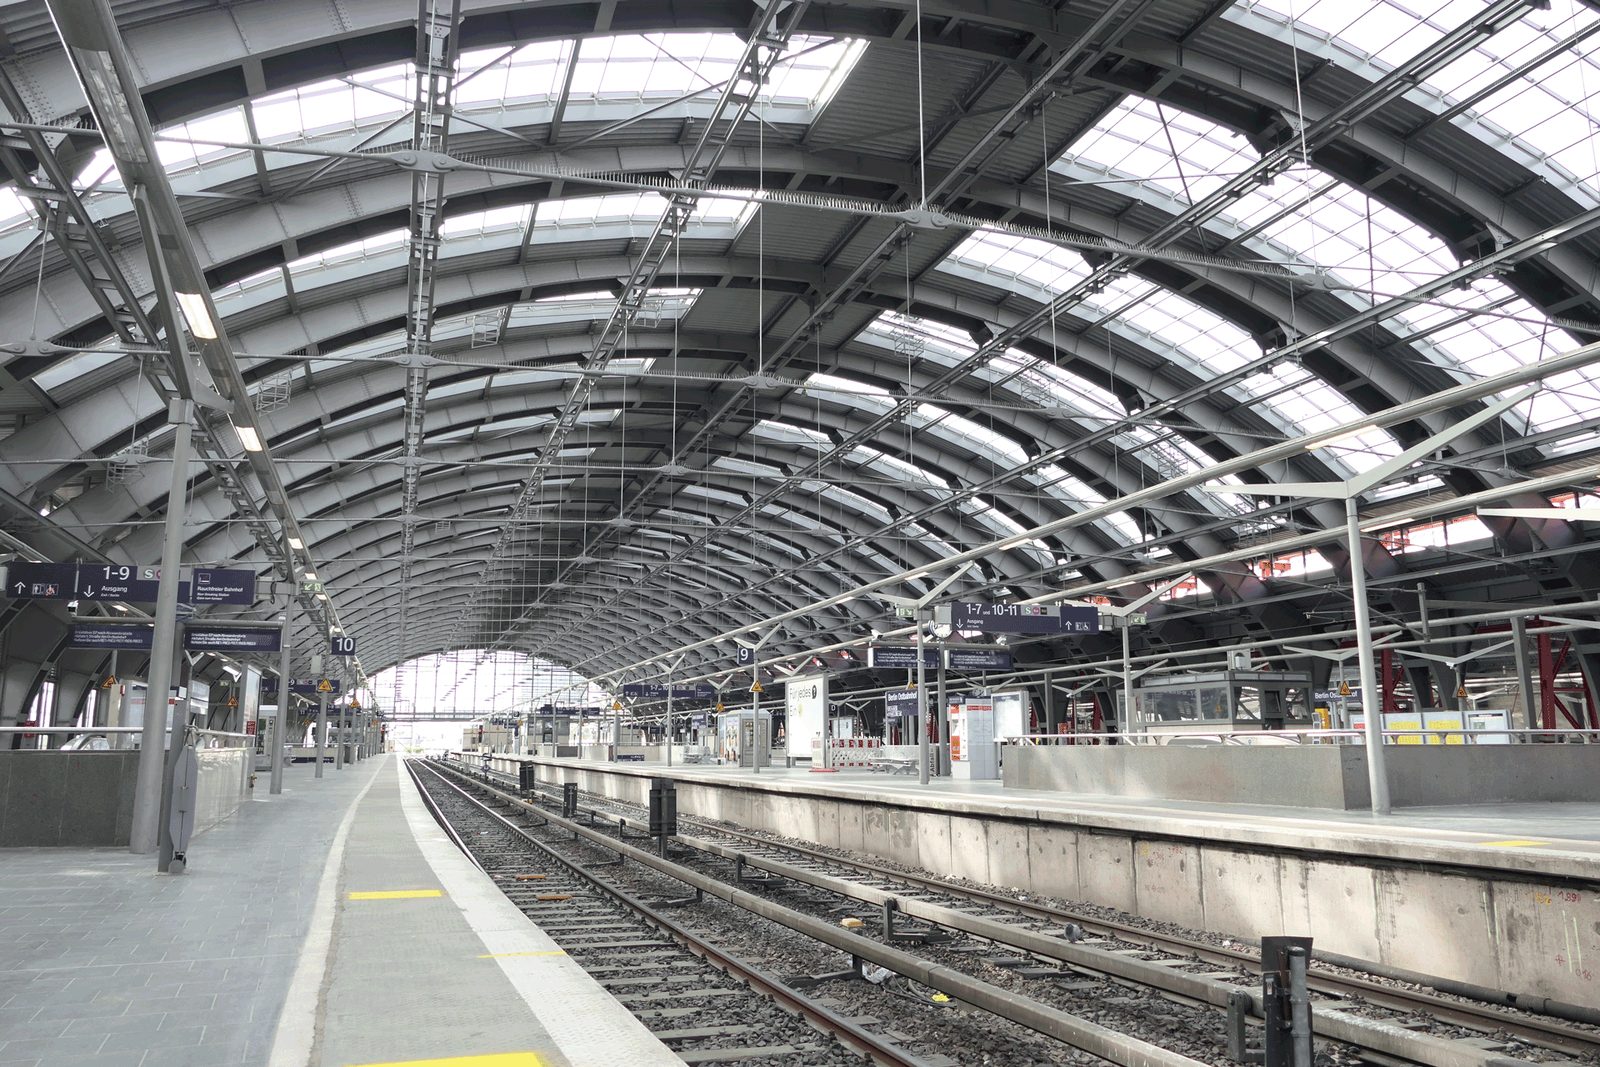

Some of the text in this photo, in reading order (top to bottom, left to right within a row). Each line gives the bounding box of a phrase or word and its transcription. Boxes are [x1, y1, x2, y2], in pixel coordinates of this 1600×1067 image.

[103, 565, 130, 581] 1-9
[966, 603, 982, 615] 1-7
[992, 604, 1017, 616] 10-11
[336, 638, 354, 652] 10
[740, 648, 748, 660] 9
[888, 693, 898, 701] Berlin
